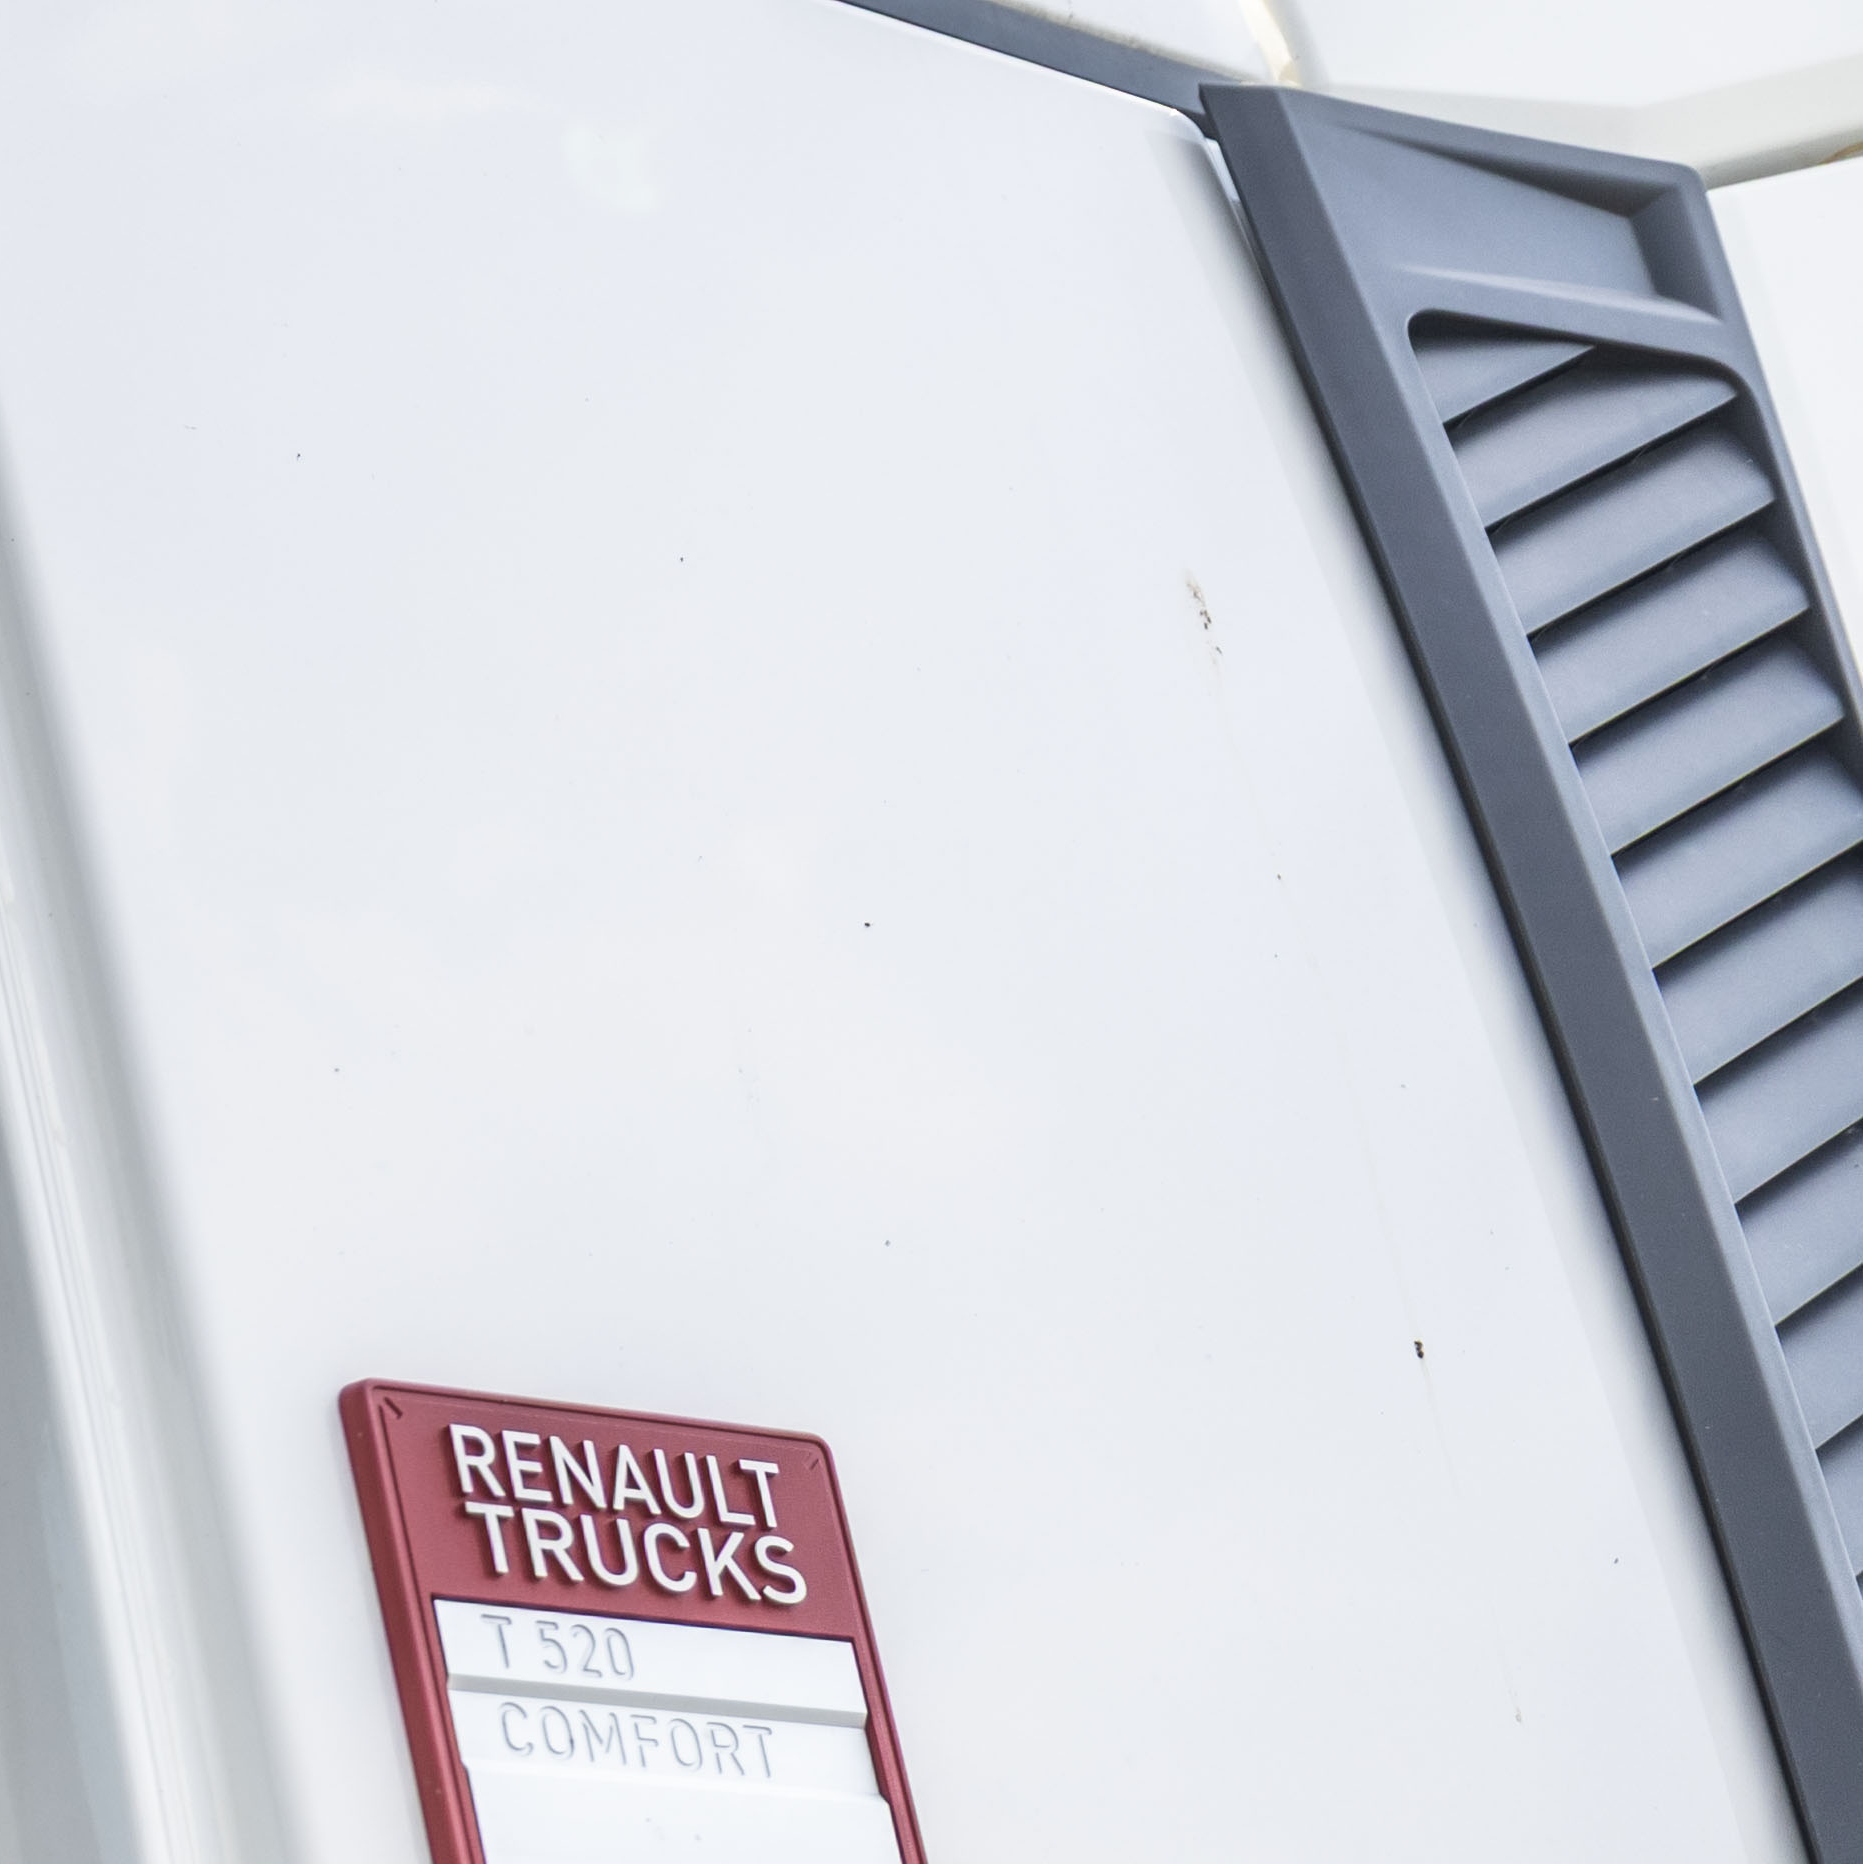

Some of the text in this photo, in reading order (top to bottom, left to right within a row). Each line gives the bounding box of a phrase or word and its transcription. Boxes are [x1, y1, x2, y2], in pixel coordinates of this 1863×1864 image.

[447, 1422, 780, 1529] RENAULT
[464, 1500, 808, 1605] TRUCKS
[480, 1613, 637, 1681] T 520
[499, 1701, 774, 1781] COMFORT
